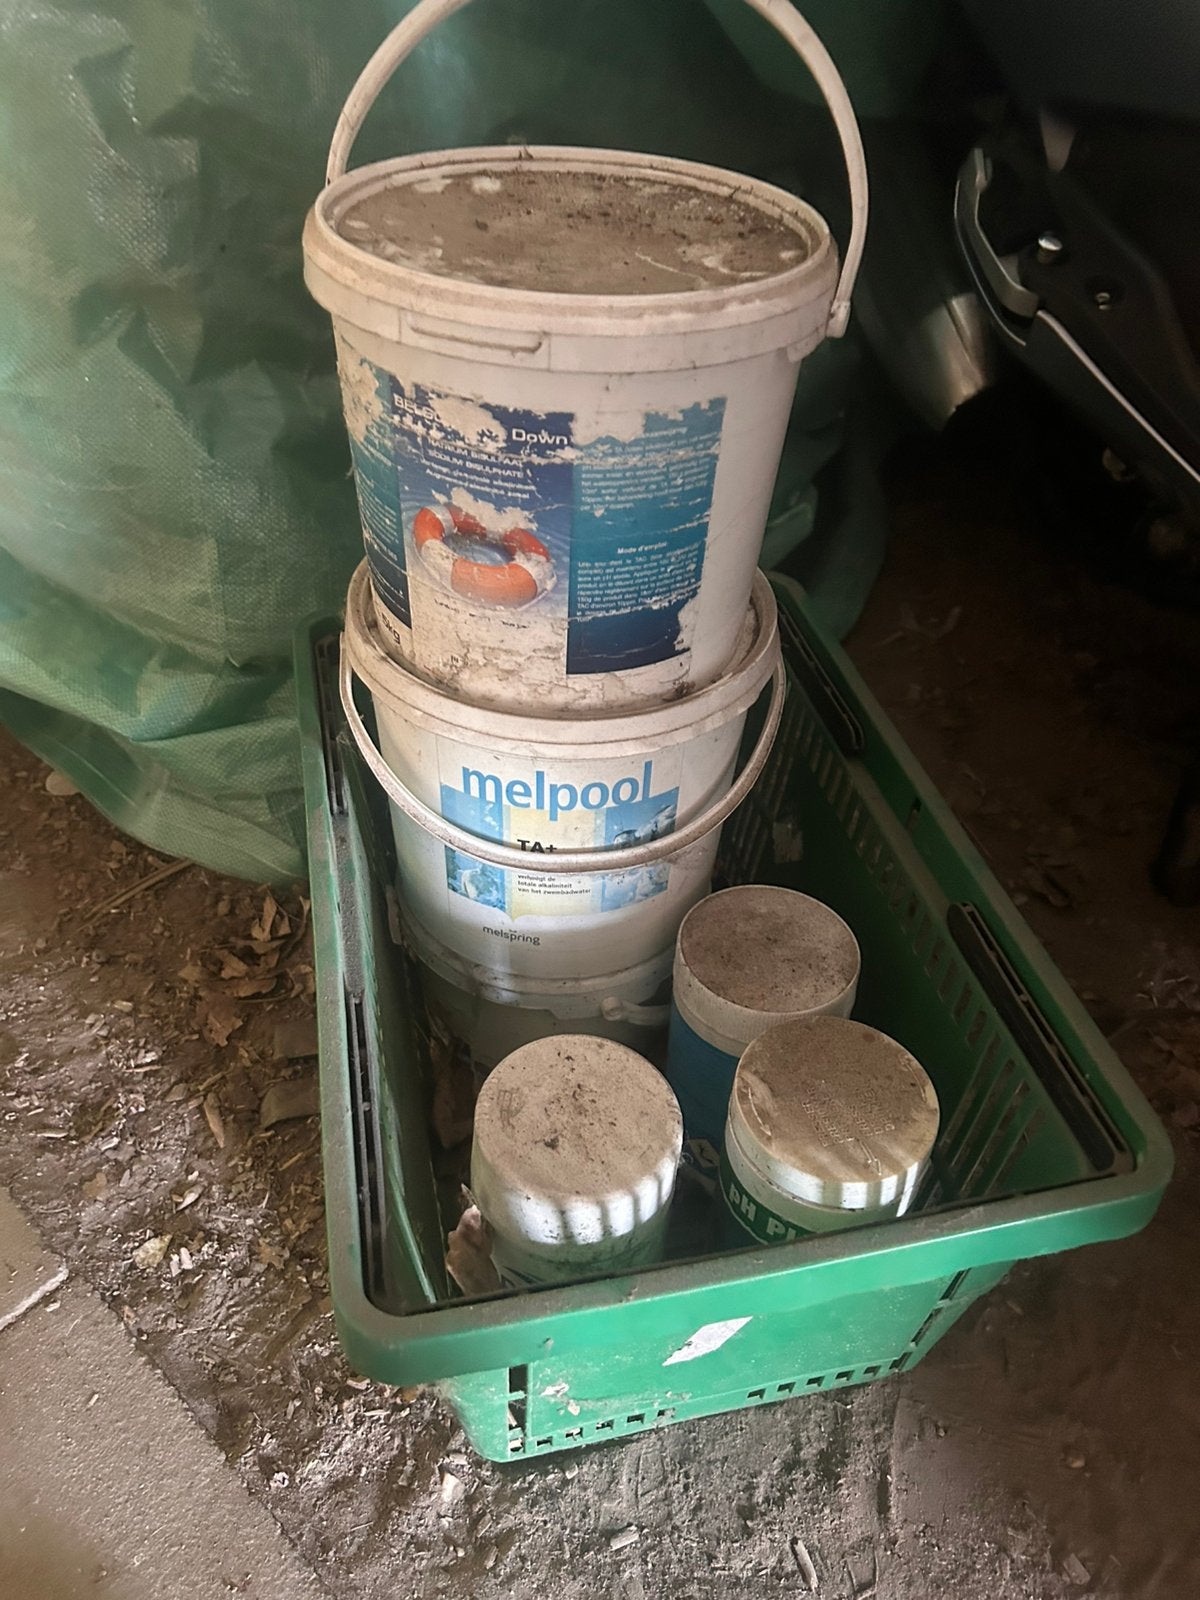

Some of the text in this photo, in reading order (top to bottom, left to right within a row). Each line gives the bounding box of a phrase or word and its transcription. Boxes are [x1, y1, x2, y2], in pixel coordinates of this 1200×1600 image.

[512, 428, 568, 446] Down
[617, 547, 636, 555] Mode
[462, 760, 653, 822] melpool
[517, 839, 558, 854] TA+
[518, 880, 537, 888] totale
[531, 887, 542, 895] het
[482, 926, 541, 947] melspring
